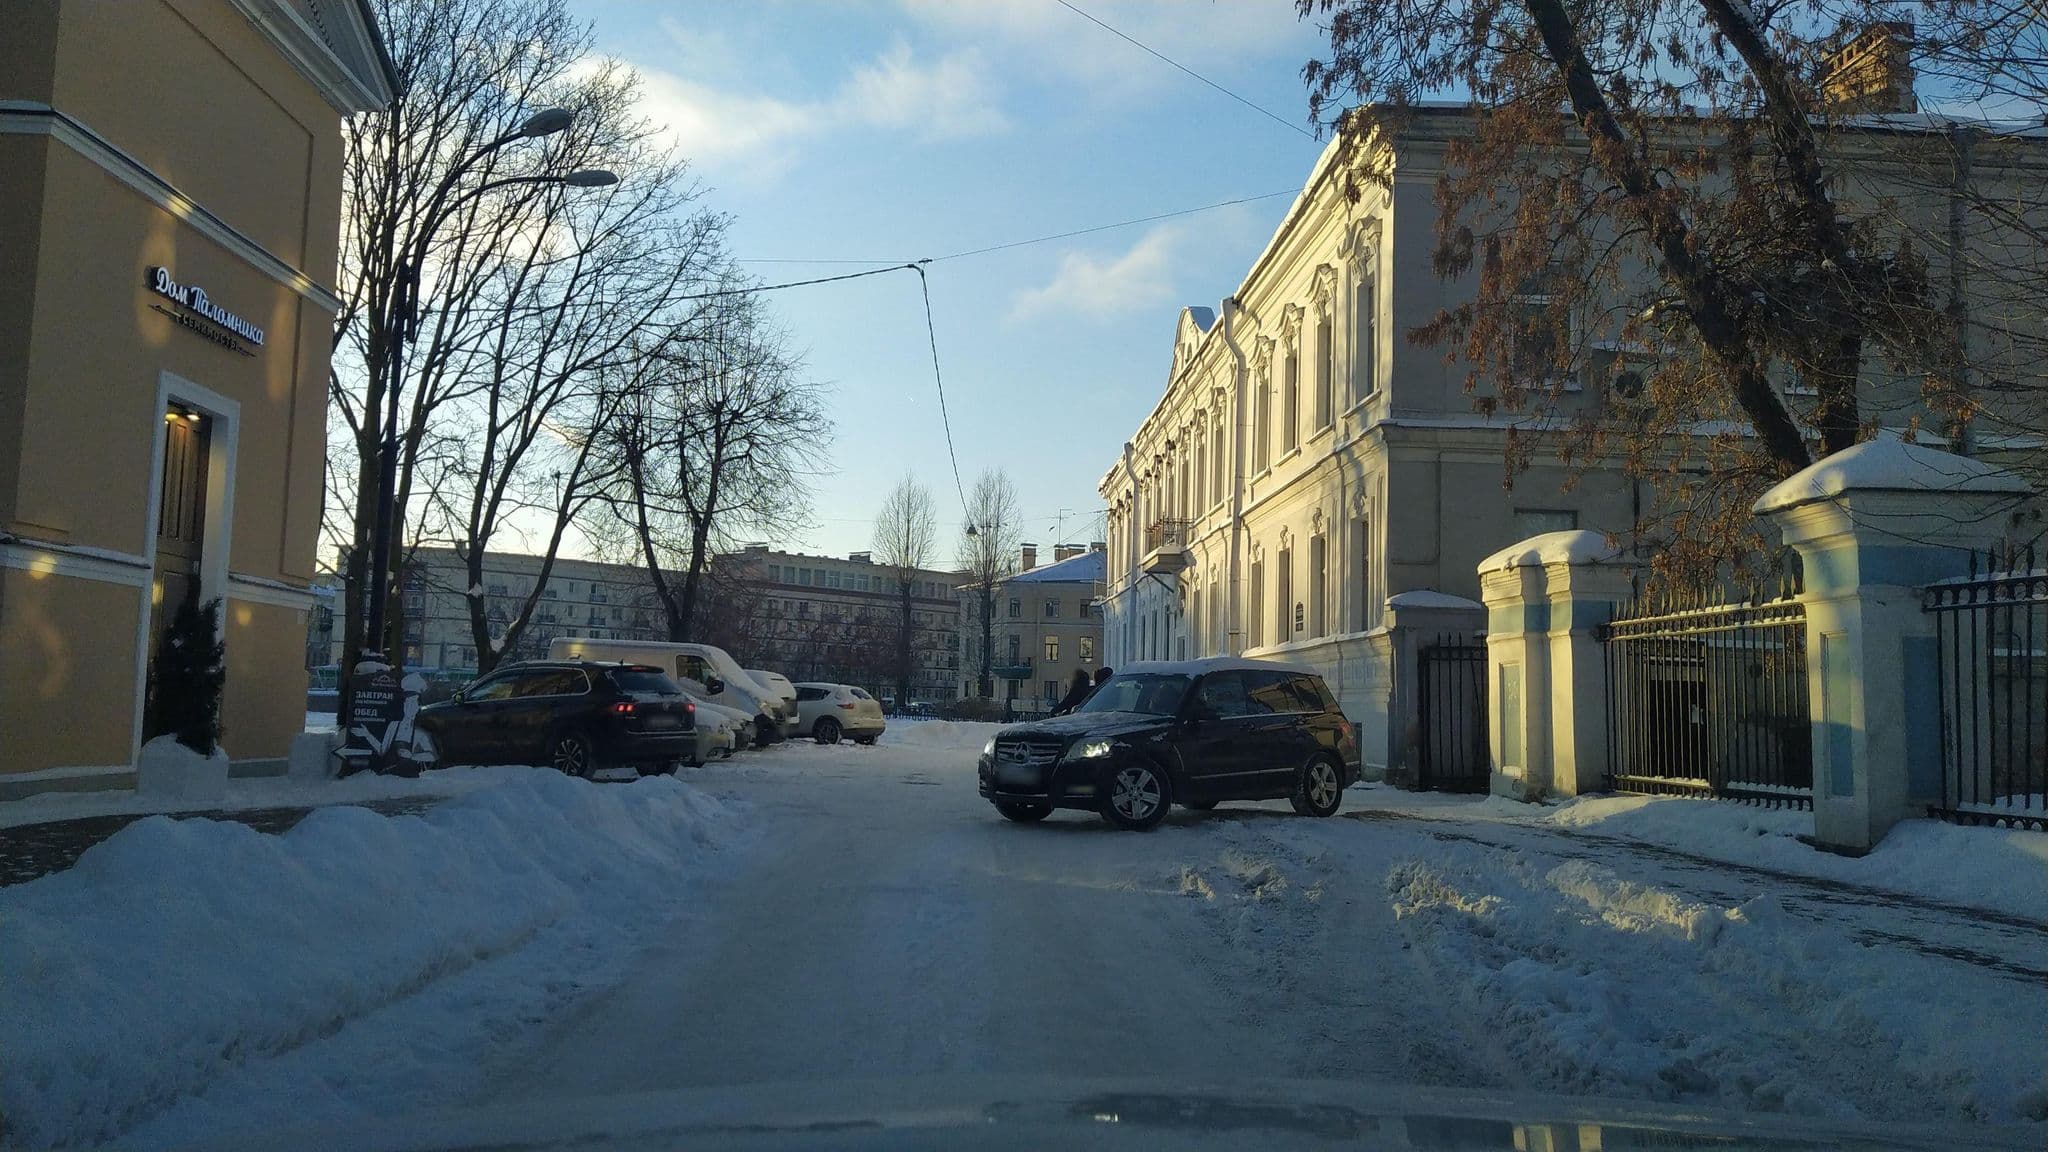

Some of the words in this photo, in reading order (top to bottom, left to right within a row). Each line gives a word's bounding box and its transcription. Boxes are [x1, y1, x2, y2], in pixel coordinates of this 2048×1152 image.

[156, 267, 188, 305] Дом
[191, 286, 264, 346] Паломника
[355, 690, 393, 700] ЗАВТРАК
[354, 707, 378, 717] ОБЕД
